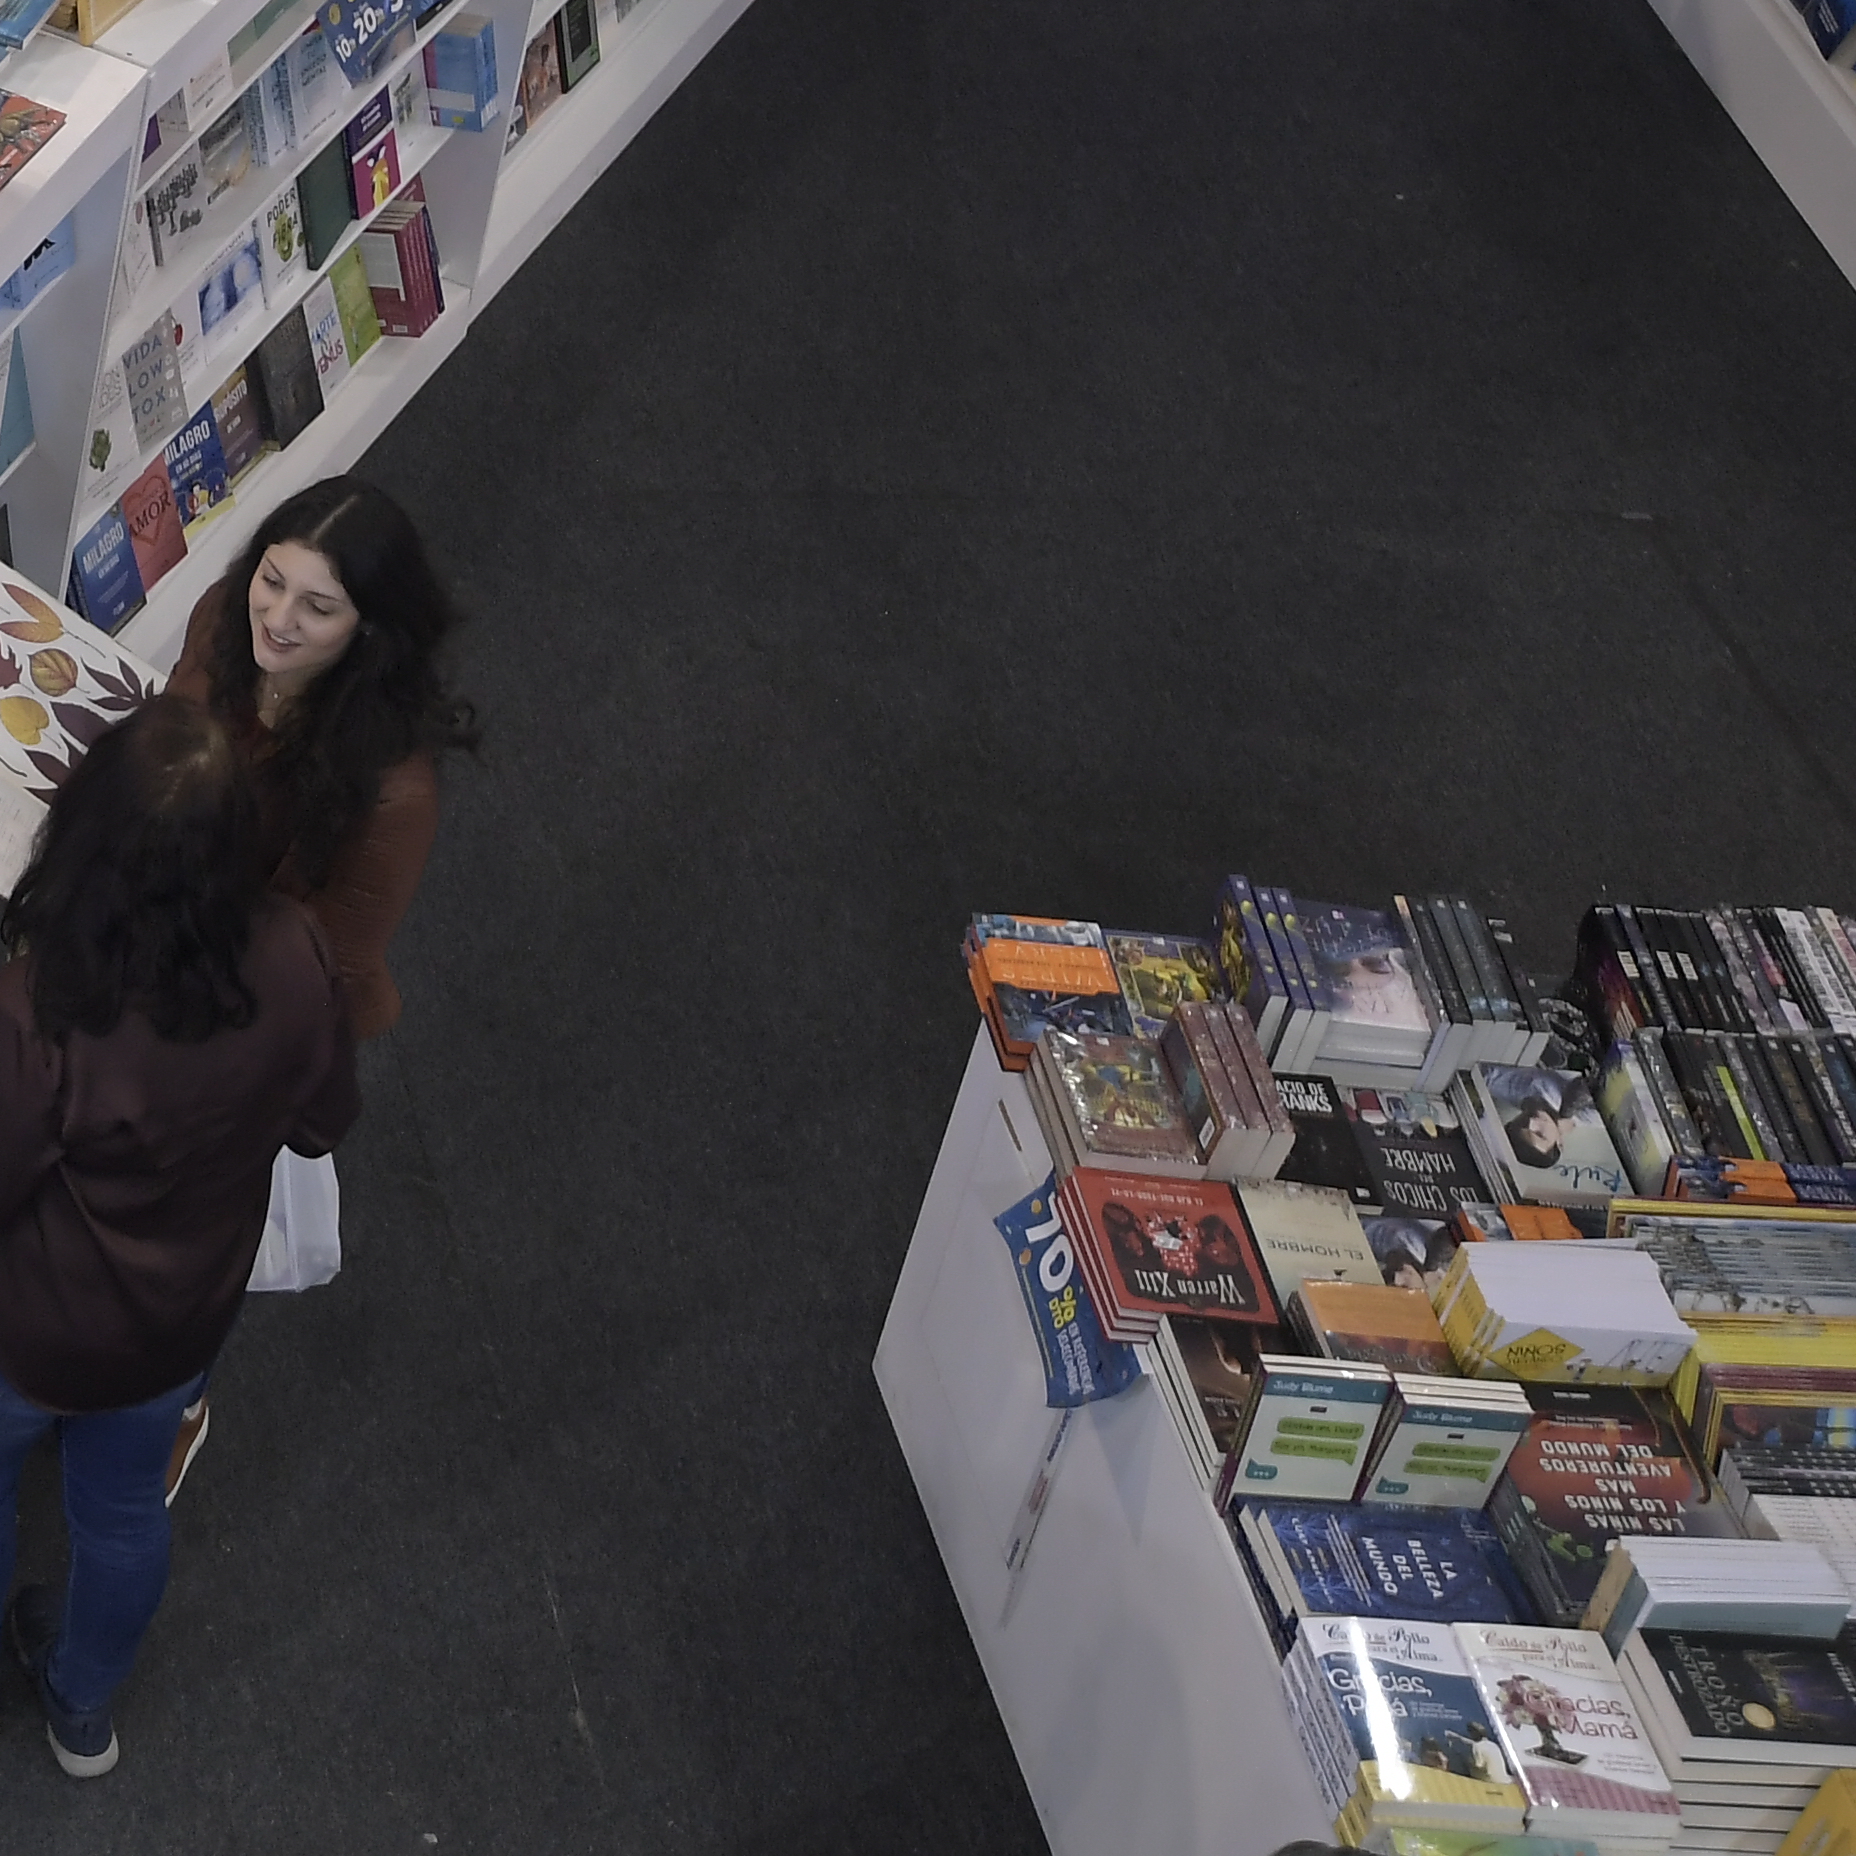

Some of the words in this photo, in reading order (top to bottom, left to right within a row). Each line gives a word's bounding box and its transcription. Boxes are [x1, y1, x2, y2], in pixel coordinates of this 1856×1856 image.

[123, 334, 163, 370] VIDA
[129, 358, 164, 399] LOW
[133, 386, 166, 423] TOX
[163, 420, 211, 463] MILAGRO
[83, 522, 124, 573] MILAGRO
[1307, 1082, 1326, 1095] DE
[1382, 1147, 1457, 1173] HAMBRE
[1384, 1179, 1448, 1212] CHICOS
[1450, 1186, 1478, 1204] LOS
[1267, 1237, 1340, 1259] HOMBRE
[1344, 1248, 1365, 1261] EL
[1135, 1268, 1177, 1298] XIII
[1178, 1274, 1246, 1306] Warren
[1273, 1381, 1297, 1394] Judy
[1541, 1440, 1610, 1457] MUNDO
[1615, 1444, 1653, 1458] DEL
[1539, 1458, 1671, 1478] AVENTUREROS
[1564, 1494, 1624, 1515] NIÑOS
[1633, 1497, 1668, 1513] LOS
[1584, 1514, 1642, 1533] NIÑAS
[1649, 1516, 1686, 1532] LAS
[1361, 1537, 1399, 1597] MUNDO
[1391, 1553, 1413, 1581] DEL
[1407, 1539, 1444, 1600] BELLEZA
[1439, 1560, 1458, 1581] LA
[1550, 1634, 1587, 1654] Pollo
[1668, 1634, 1731, 1737] DESTROZADO
[1695, 1644, 1745, 1729] TRONO
[1558, 1712, 1639, 1741] Mamá
